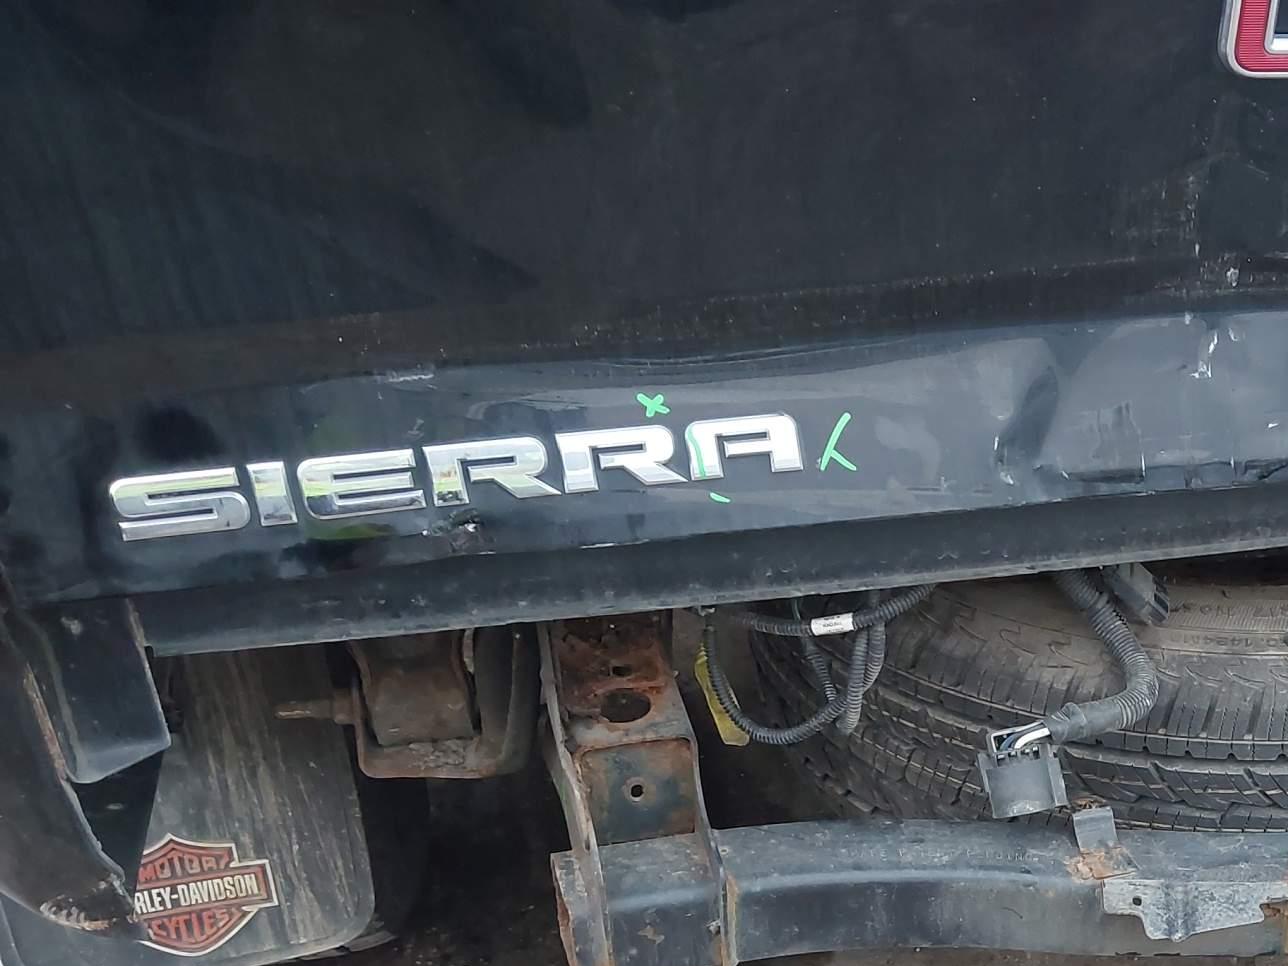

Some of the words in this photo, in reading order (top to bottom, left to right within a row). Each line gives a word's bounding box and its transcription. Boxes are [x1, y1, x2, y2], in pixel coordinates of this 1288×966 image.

[109, 411, 804, 542] SIERRA
[138, 851, 219, 882] MOTOR
[134, 873, 259, 915] RLEY-DAVIDSON
[152, 908, 230, 943] CYCLES
